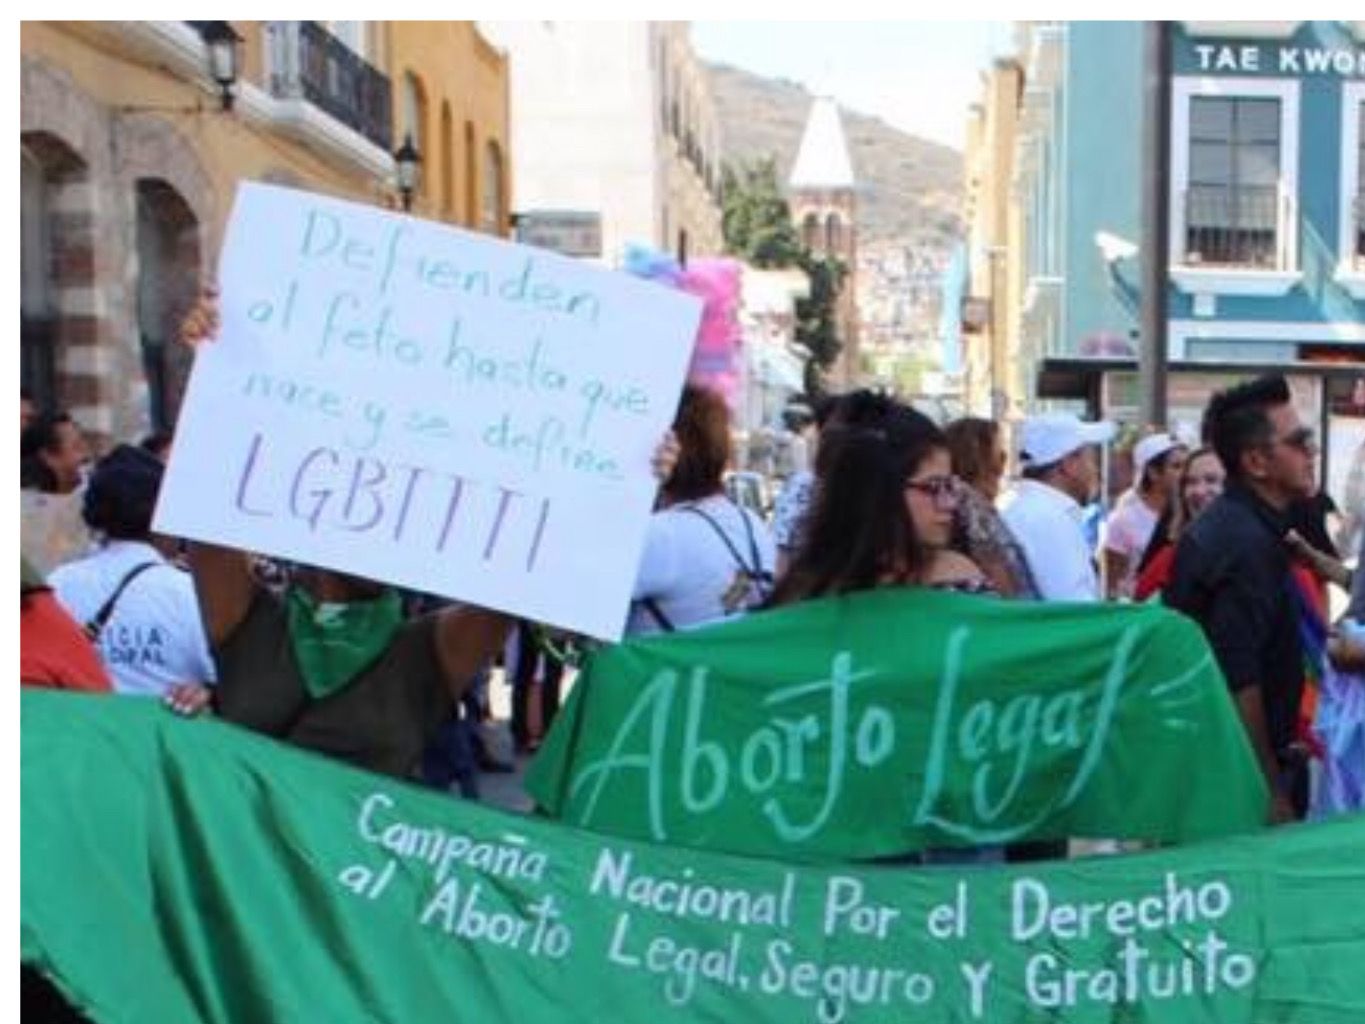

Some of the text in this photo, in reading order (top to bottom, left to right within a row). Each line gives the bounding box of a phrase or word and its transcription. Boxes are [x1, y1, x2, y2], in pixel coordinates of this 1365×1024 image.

[1196, 44, 1260, 72] TAE
[301, 207, 600, 326] Defienden
[242, 372, 341, 418] nace
[343, 398, 387, 451] y
[482, 412, 626, 480] define
[247, 281, 650, 441] al feto hasta que
[106, 627, 164, 645] ICIA
[573, 624, 1146, 844] Aborto Legal
[357, 793, 1233, 943] Campaña Nacional Por el Derecho
[338, 860, 389, 900] al
[420, 878, 573, 961] Aborto
[962, 963, 994, 1016] Y
[1025, 934, 1258, 1006] Gratuito
